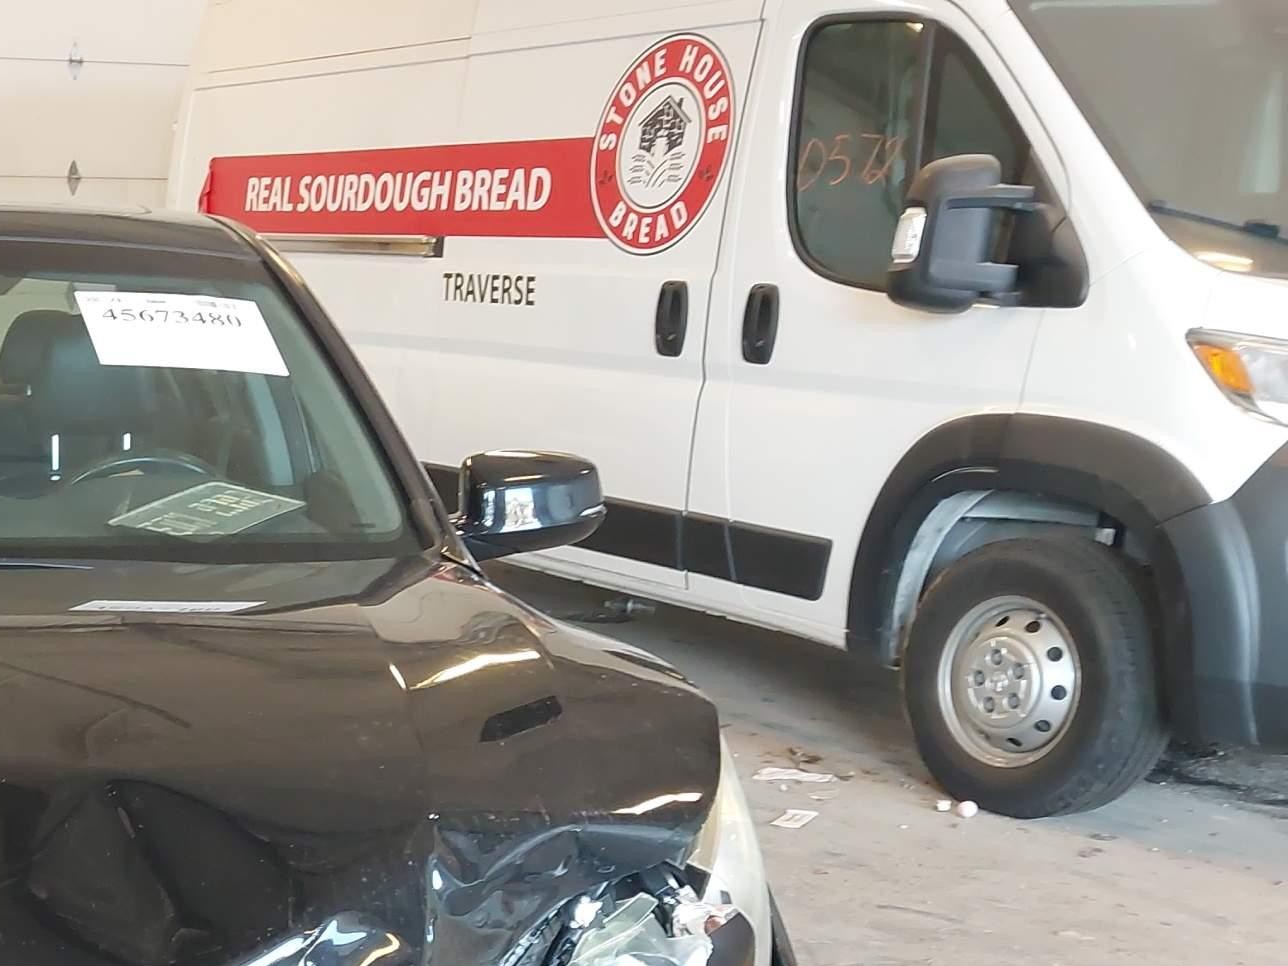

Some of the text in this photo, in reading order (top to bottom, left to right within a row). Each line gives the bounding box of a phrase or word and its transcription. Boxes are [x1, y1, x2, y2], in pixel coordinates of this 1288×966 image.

[599, 44, 729, 150] STONE HOUSE
[244, 167, 552, 213] REAL SOURDOUGH BREAD
[608, 200, 689, 243] BREAD
[443, 272, 536, 306] TRAVERSE
[102, 308, 242, 328] 45673480
